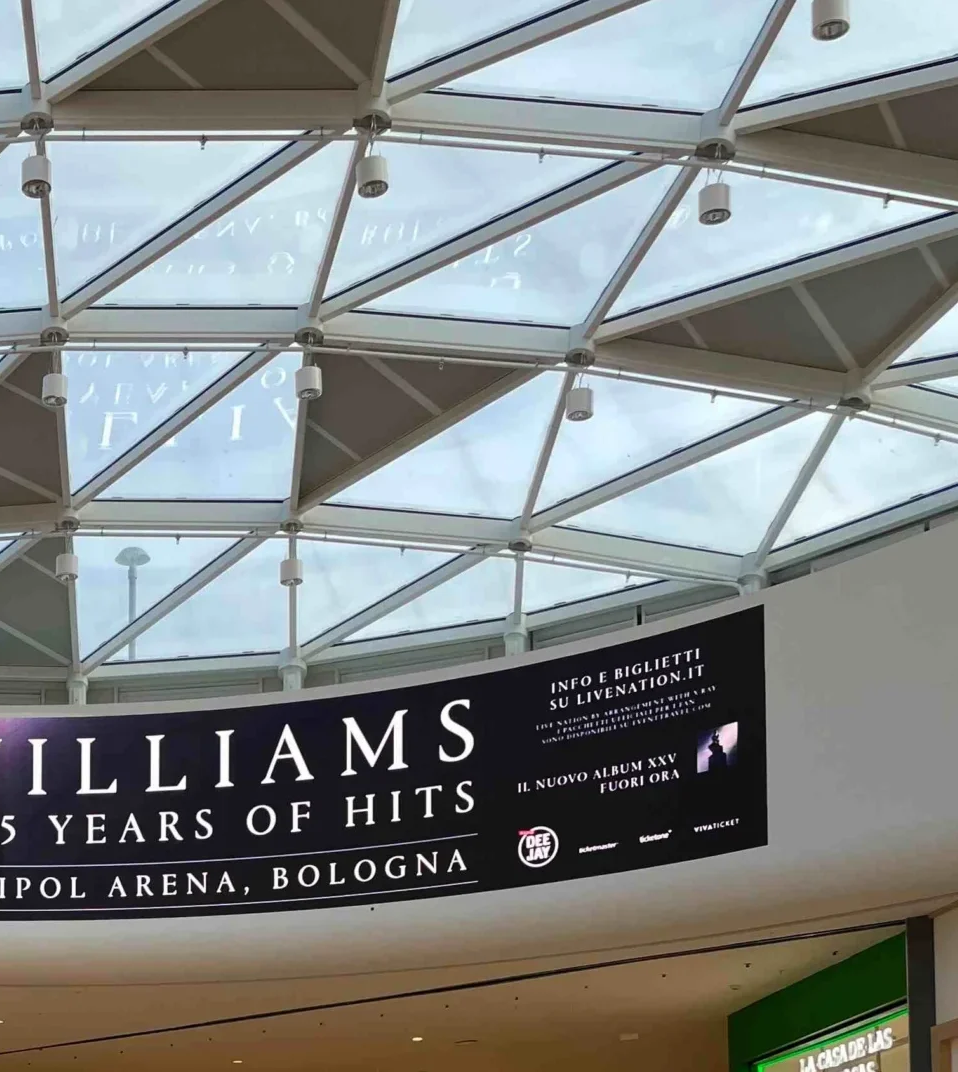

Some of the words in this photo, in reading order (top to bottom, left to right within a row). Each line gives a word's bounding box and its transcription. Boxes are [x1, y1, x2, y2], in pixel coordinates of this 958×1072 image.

[549, 697, 569, 711] SU
[577, 664, 706, 706] LIVENATION.IT
[550, 676, 592, 694] INFO
[599, 671, 608, 684] E
[614, 648, 701, 680] BIGLIETTI
[517, 782, 531, 793] IL
[536, 771, 588, 790] NUOVO
[593, 760, 643, 780] ALBUM
[648, 753, 677, 770] XXV
[600, 776, 644, 794] FUORI
[649, 769, 680, 783] ORA
[48, 809, 214, 845] YEARS
[246, 801, 311, 836] OF
[345, 780, 475, 828] HITS
[694, 818, 740, 833] VIVATICKET
[526, 832, 551, 849] DEE
[526, 845, 551, 861] JAY
[108, 870, 250, 897] ARENA,
[272, 848, 467, 890] BOLOGNA
[817, 1043, 848, 1070] CASA
[848, 1037, 866, 1061] DE
[867, 1027, 893, 1054] LAS
